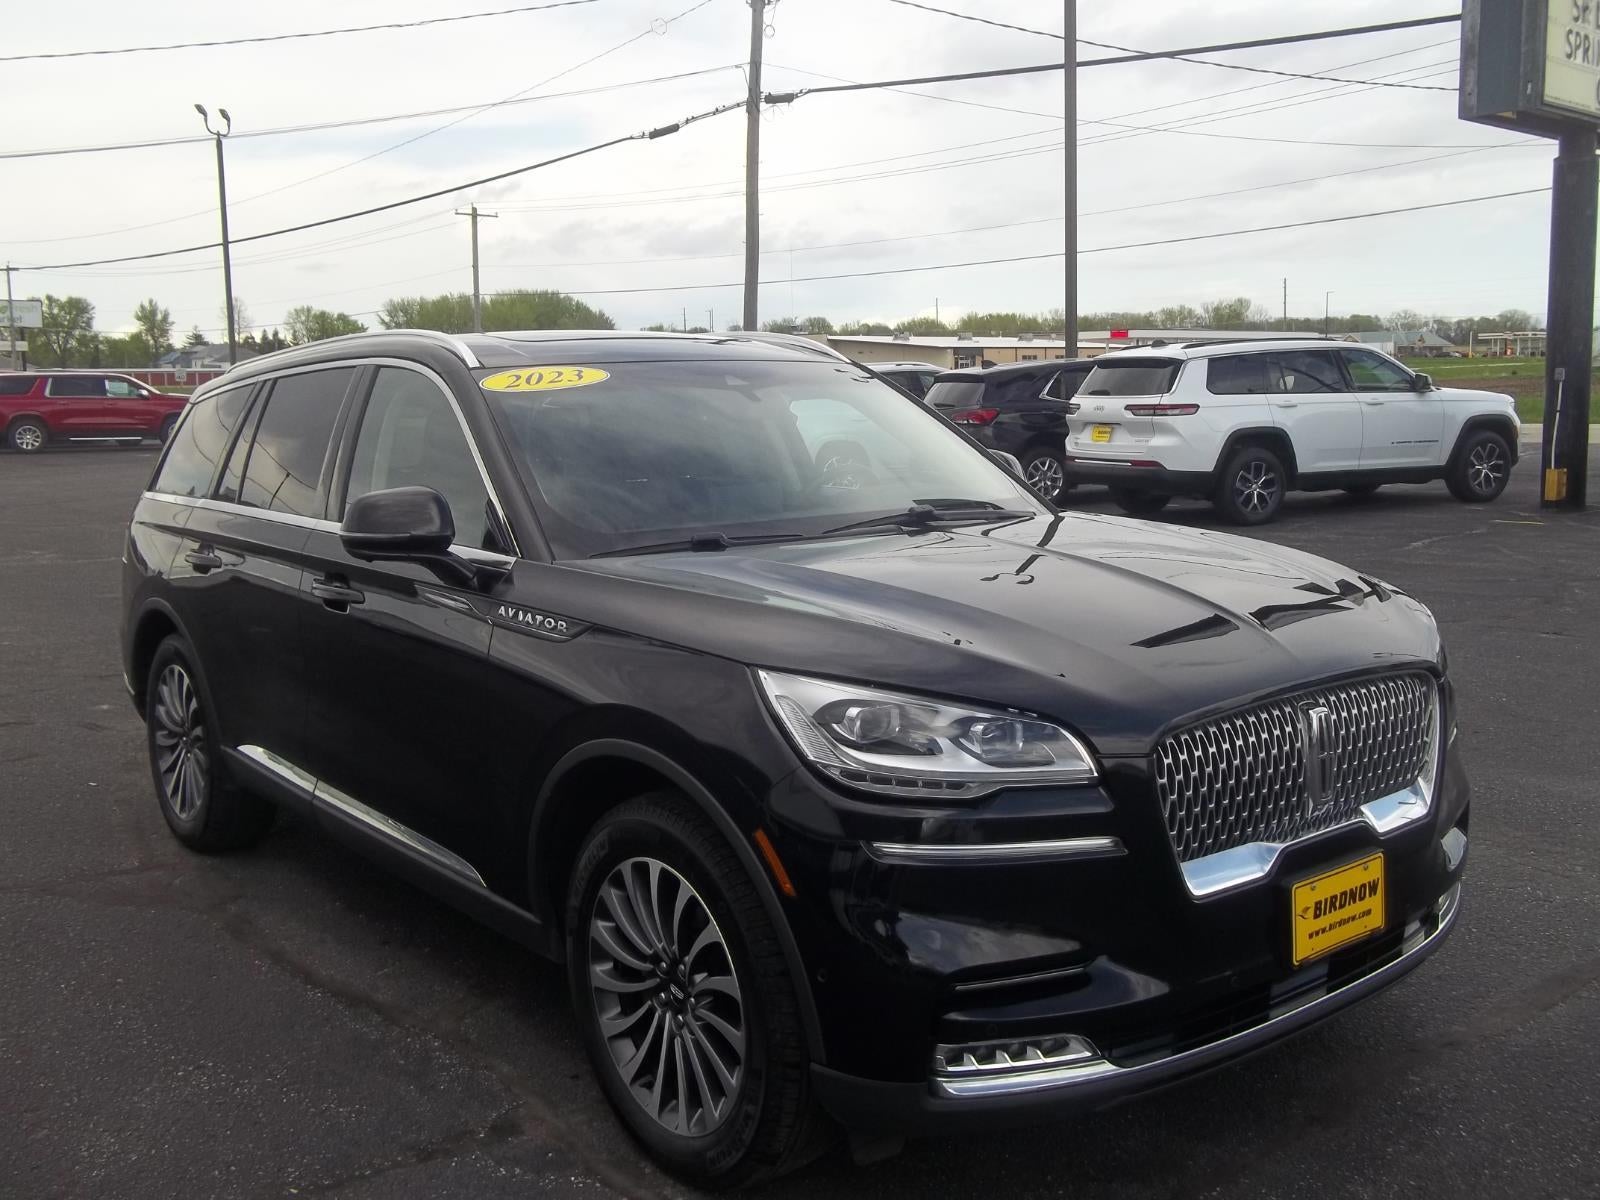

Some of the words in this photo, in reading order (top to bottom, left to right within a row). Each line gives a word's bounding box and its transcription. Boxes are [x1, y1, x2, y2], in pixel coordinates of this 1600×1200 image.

[505, 369, 584, 389] 2023
[498, 605, 567, 633] AVIATOR
[1313, 877, 1380, 920] BIRDNOW
[1308, 908, 1372, 940] www.birdnow.com
